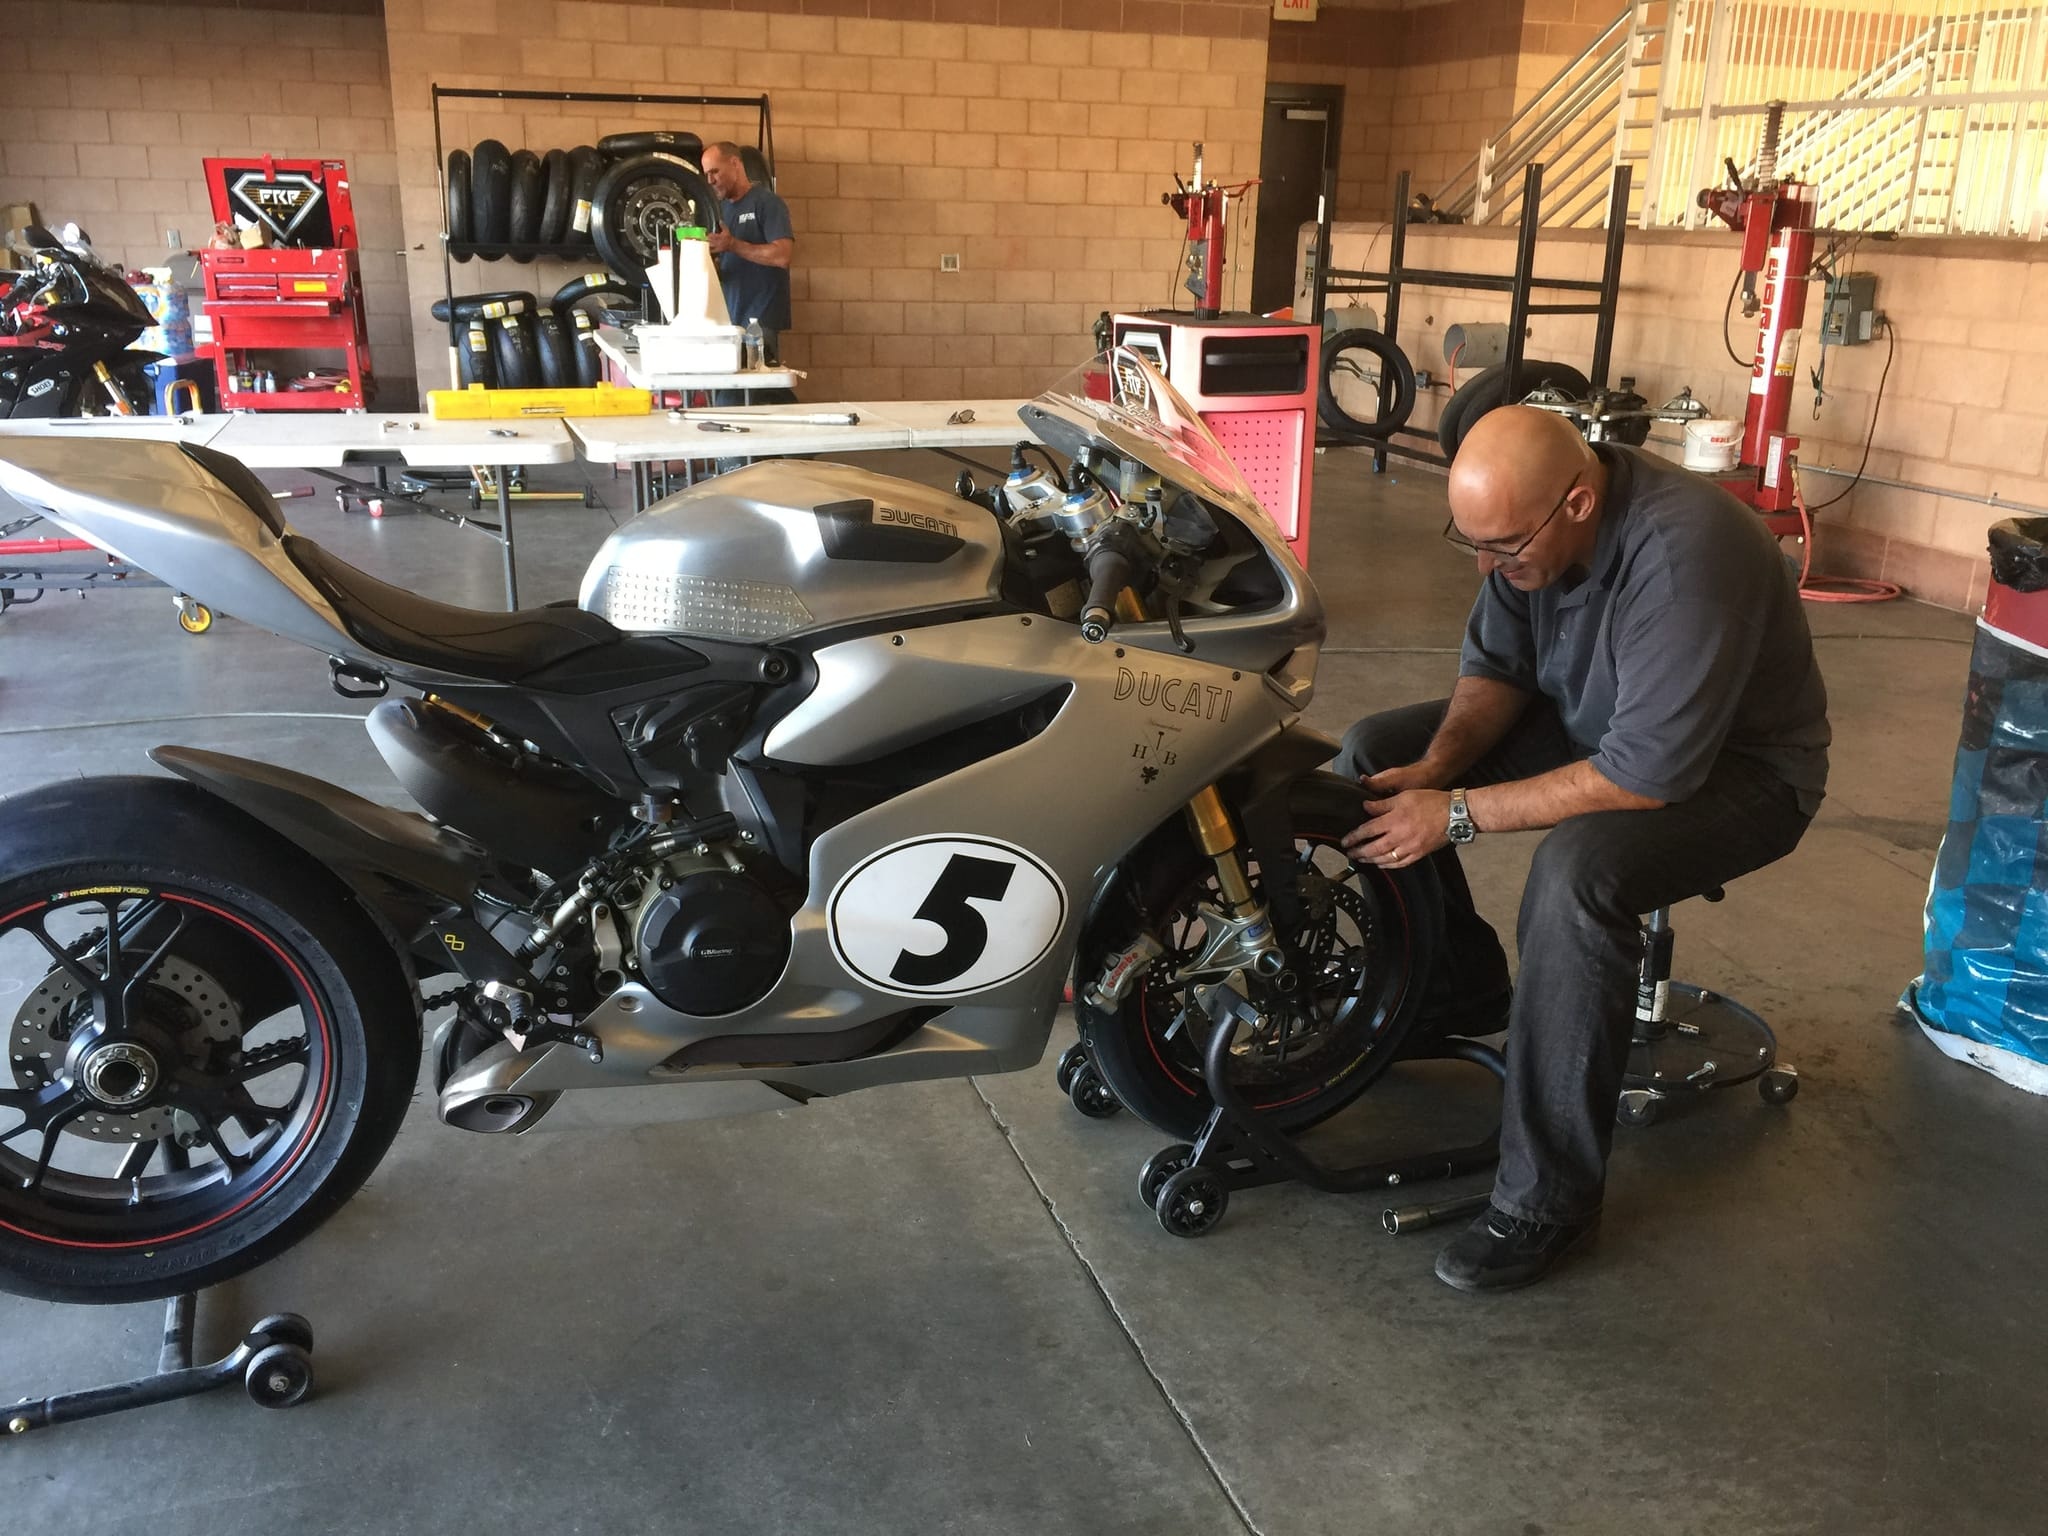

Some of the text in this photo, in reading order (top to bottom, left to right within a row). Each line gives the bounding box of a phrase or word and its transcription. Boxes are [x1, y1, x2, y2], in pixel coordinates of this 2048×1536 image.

[879, 507, 959, 538] DUCATI
[1113, 666, 1233, 723] DUCATI
[1132, 743, 1178, 766] H B
[889, 853, 1017, 986] 5
[1106, 951, 1139, 989] brembo
